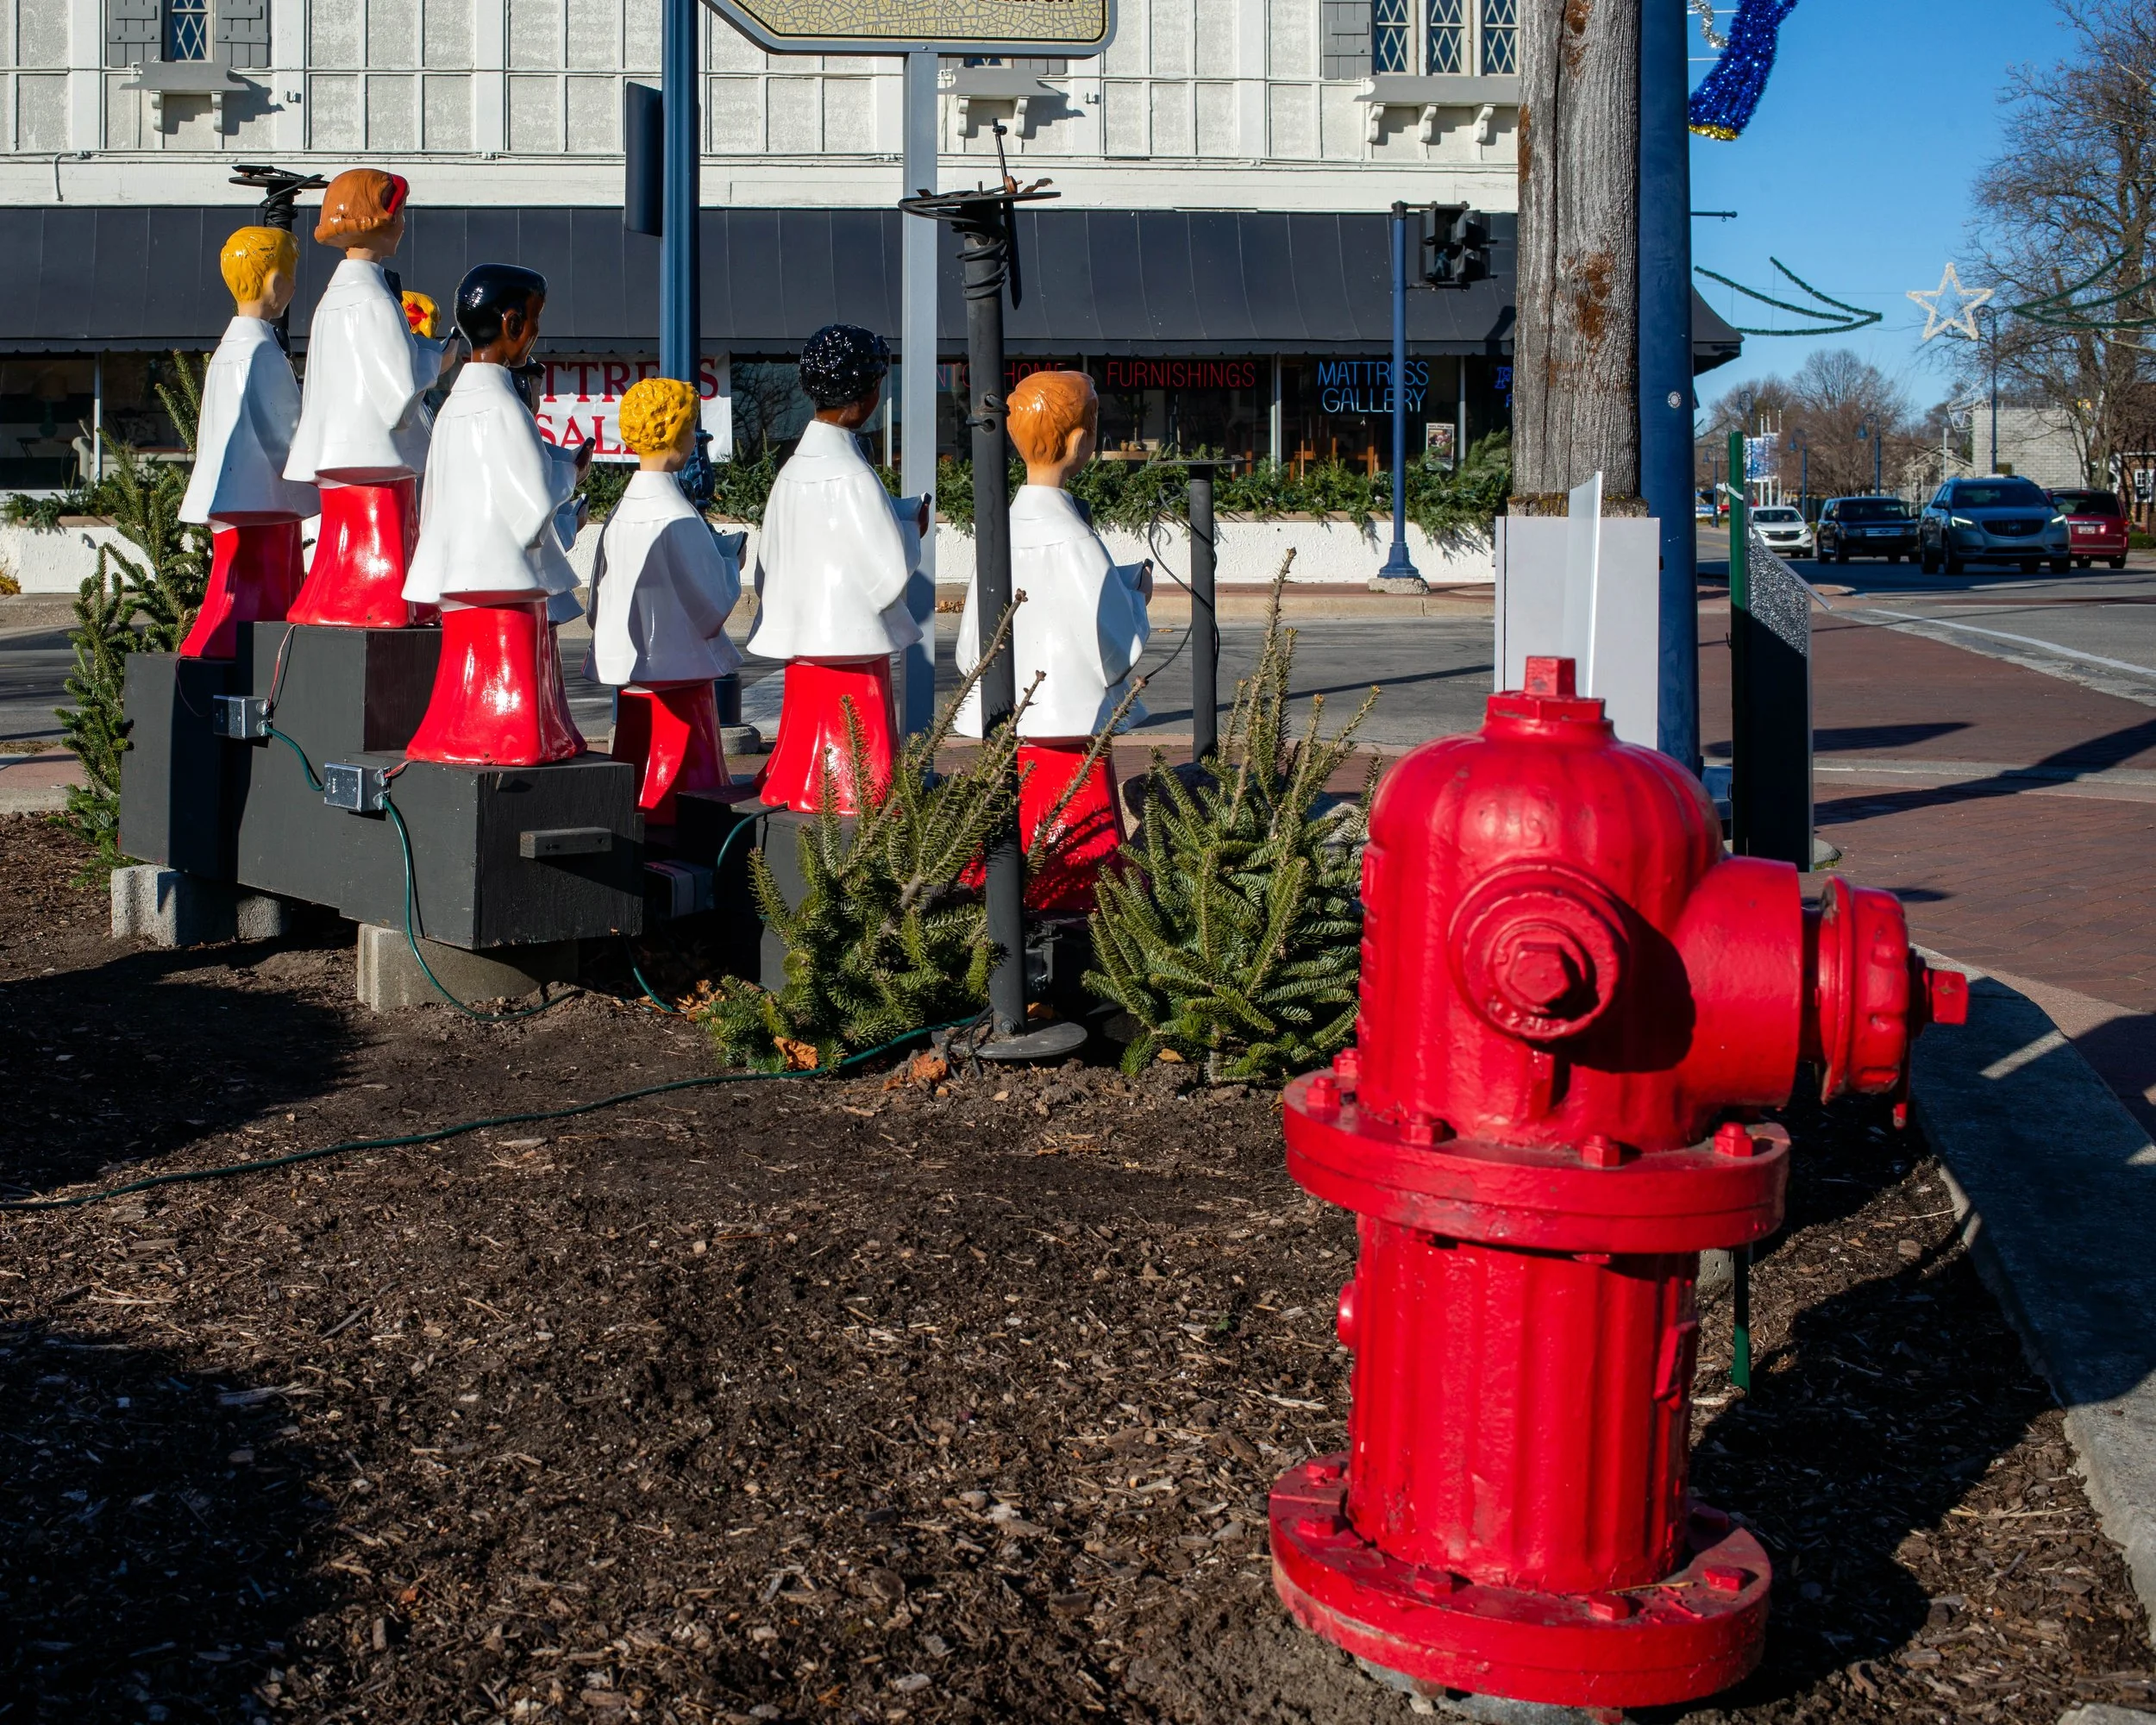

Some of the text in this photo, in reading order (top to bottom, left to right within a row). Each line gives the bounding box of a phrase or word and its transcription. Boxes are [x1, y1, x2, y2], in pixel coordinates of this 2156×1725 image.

[1106, 361, 1256, 387] FURNISHINGS
[1322, 387, 1426, 413] GALLERY
[535, 413, 640, 455] SAL
